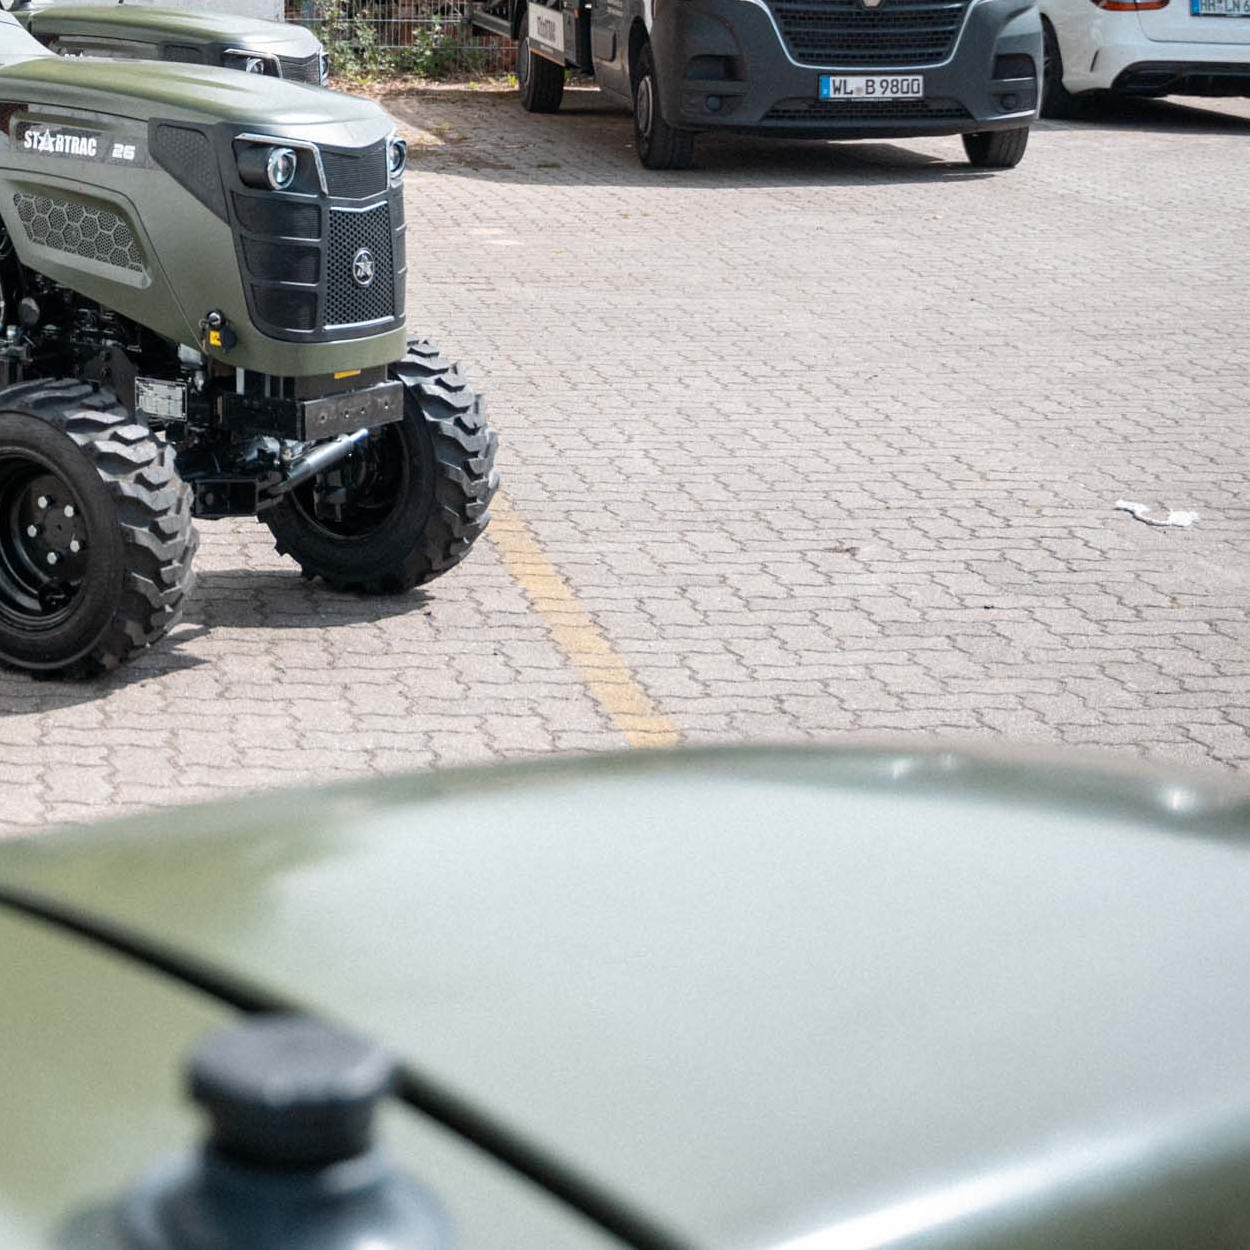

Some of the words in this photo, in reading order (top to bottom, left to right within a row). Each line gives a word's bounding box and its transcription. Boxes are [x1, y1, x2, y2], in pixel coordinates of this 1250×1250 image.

[832, 78, 853, 95] WL
[865, 78, 876, 95] B
[879, 78, 921, 95] 9800
[24, 129, 97, 157] STARTRAC
[112, 143, 135, 160] 26
